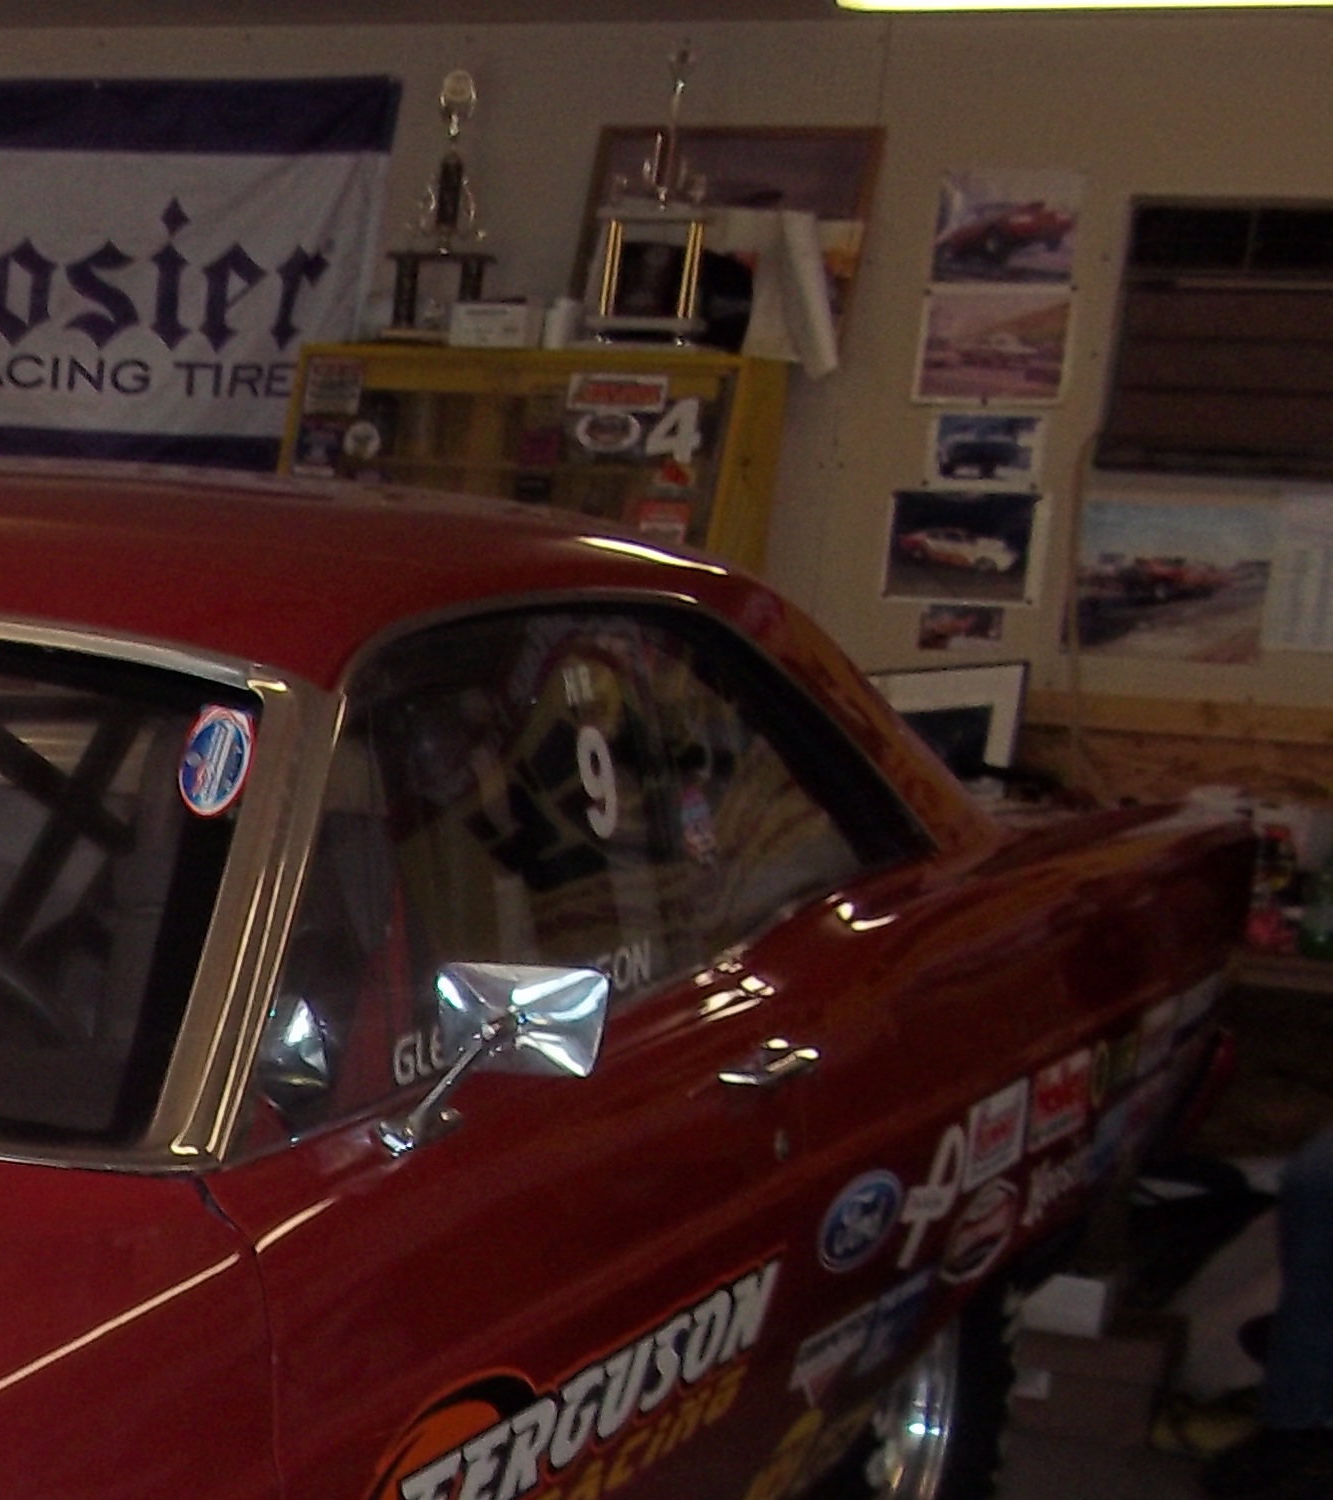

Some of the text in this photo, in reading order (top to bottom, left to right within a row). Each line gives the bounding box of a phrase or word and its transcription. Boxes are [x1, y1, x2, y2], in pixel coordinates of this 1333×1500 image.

[645, 398, 702, 463] 4
[576, 724, 618, 839] 9
[393, 1023, 445, 1086] GLE
